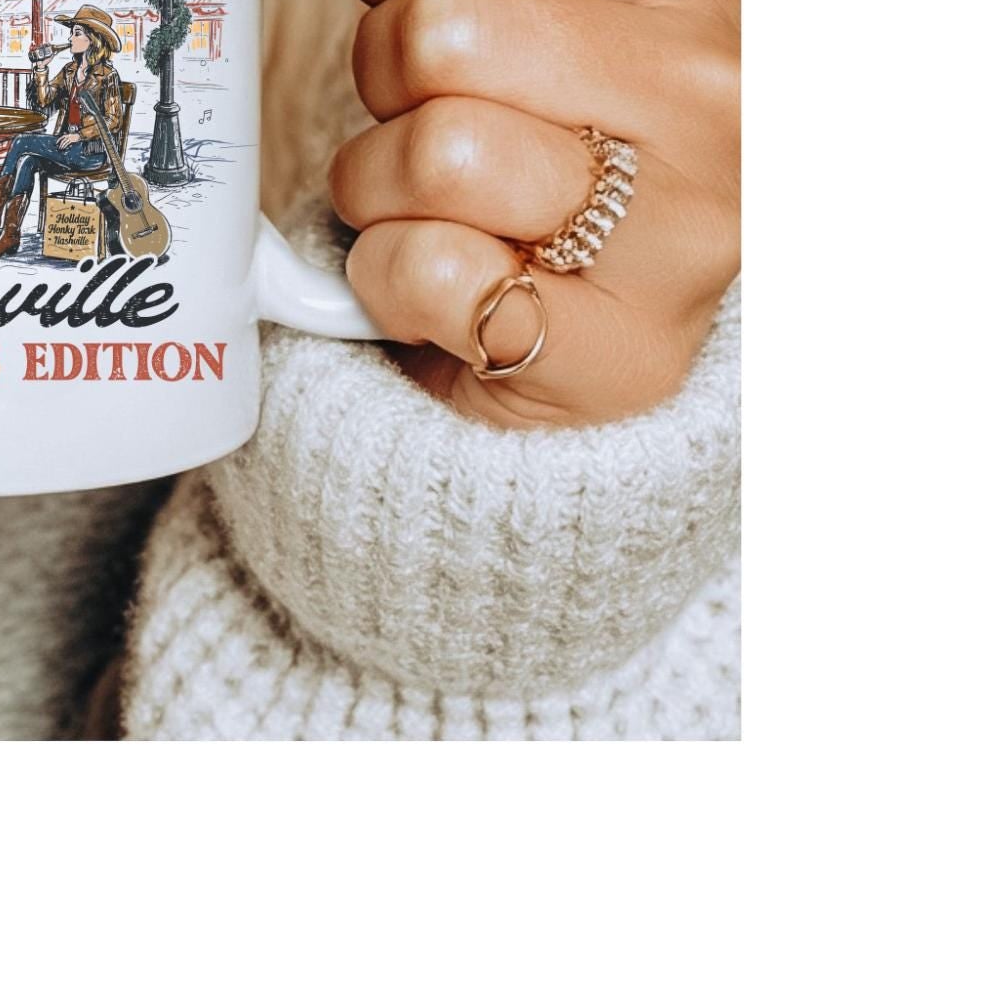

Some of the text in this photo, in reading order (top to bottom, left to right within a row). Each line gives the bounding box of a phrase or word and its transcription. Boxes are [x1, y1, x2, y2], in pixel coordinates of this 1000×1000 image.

[48, 224, 76, 238] Honky
[54, 235, 90, 246] Nashville
[23, 342, 227, 381] EDITION
